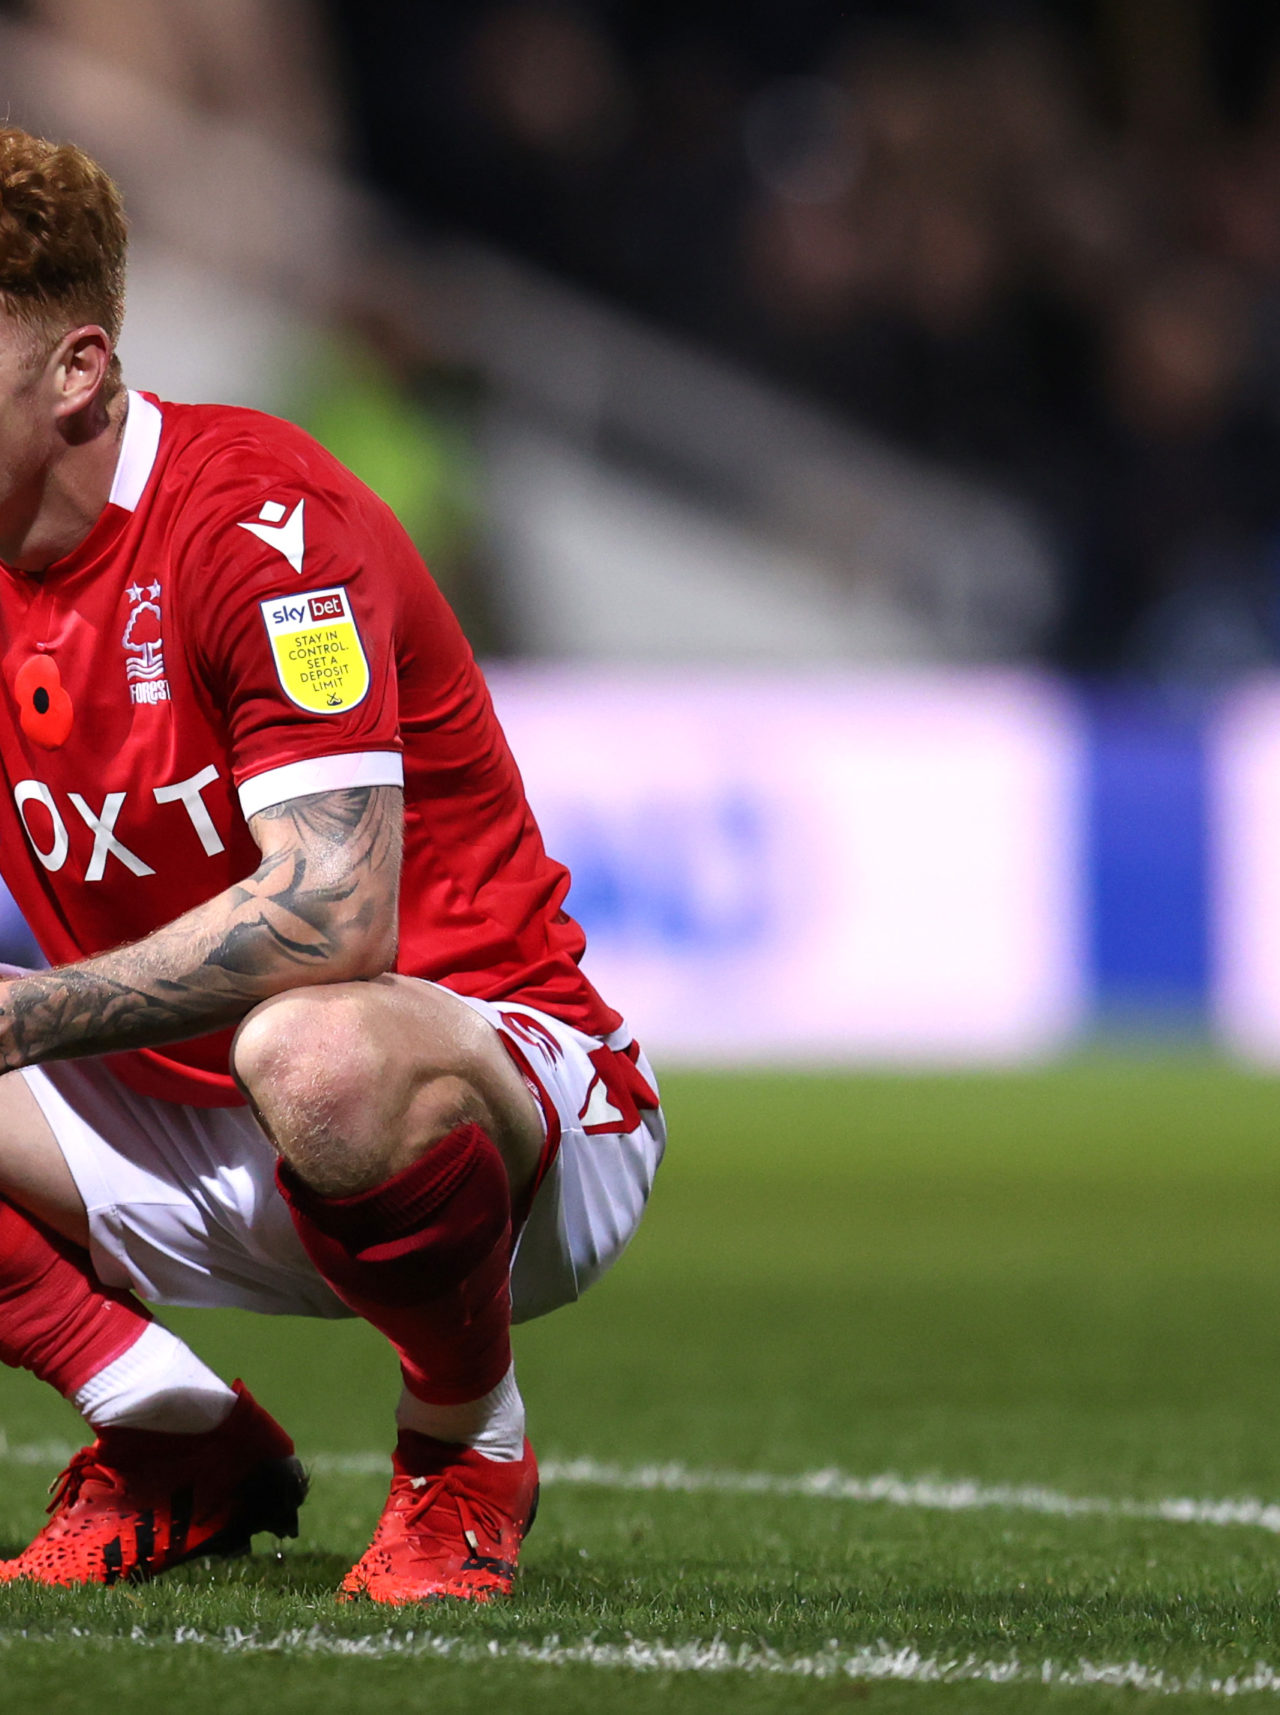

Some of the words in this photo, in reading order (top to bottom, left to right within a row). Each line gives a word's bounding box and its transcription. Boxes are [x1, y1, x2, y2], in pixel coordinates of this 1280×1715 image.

[272, 605, 305, 624] sky
[311, 597, 341, 617] bet
[295, 633, 322, 647] STAY
[326, 631, 337, 641] IN
[289, 641, 349, 660] CONTROL.
[307, 656, 326, 669] SET
[331, 656, 338, 664] A
[300, 664, 349, 682] DEPOSIT
[313, 677, 343, 692] LIMIT
